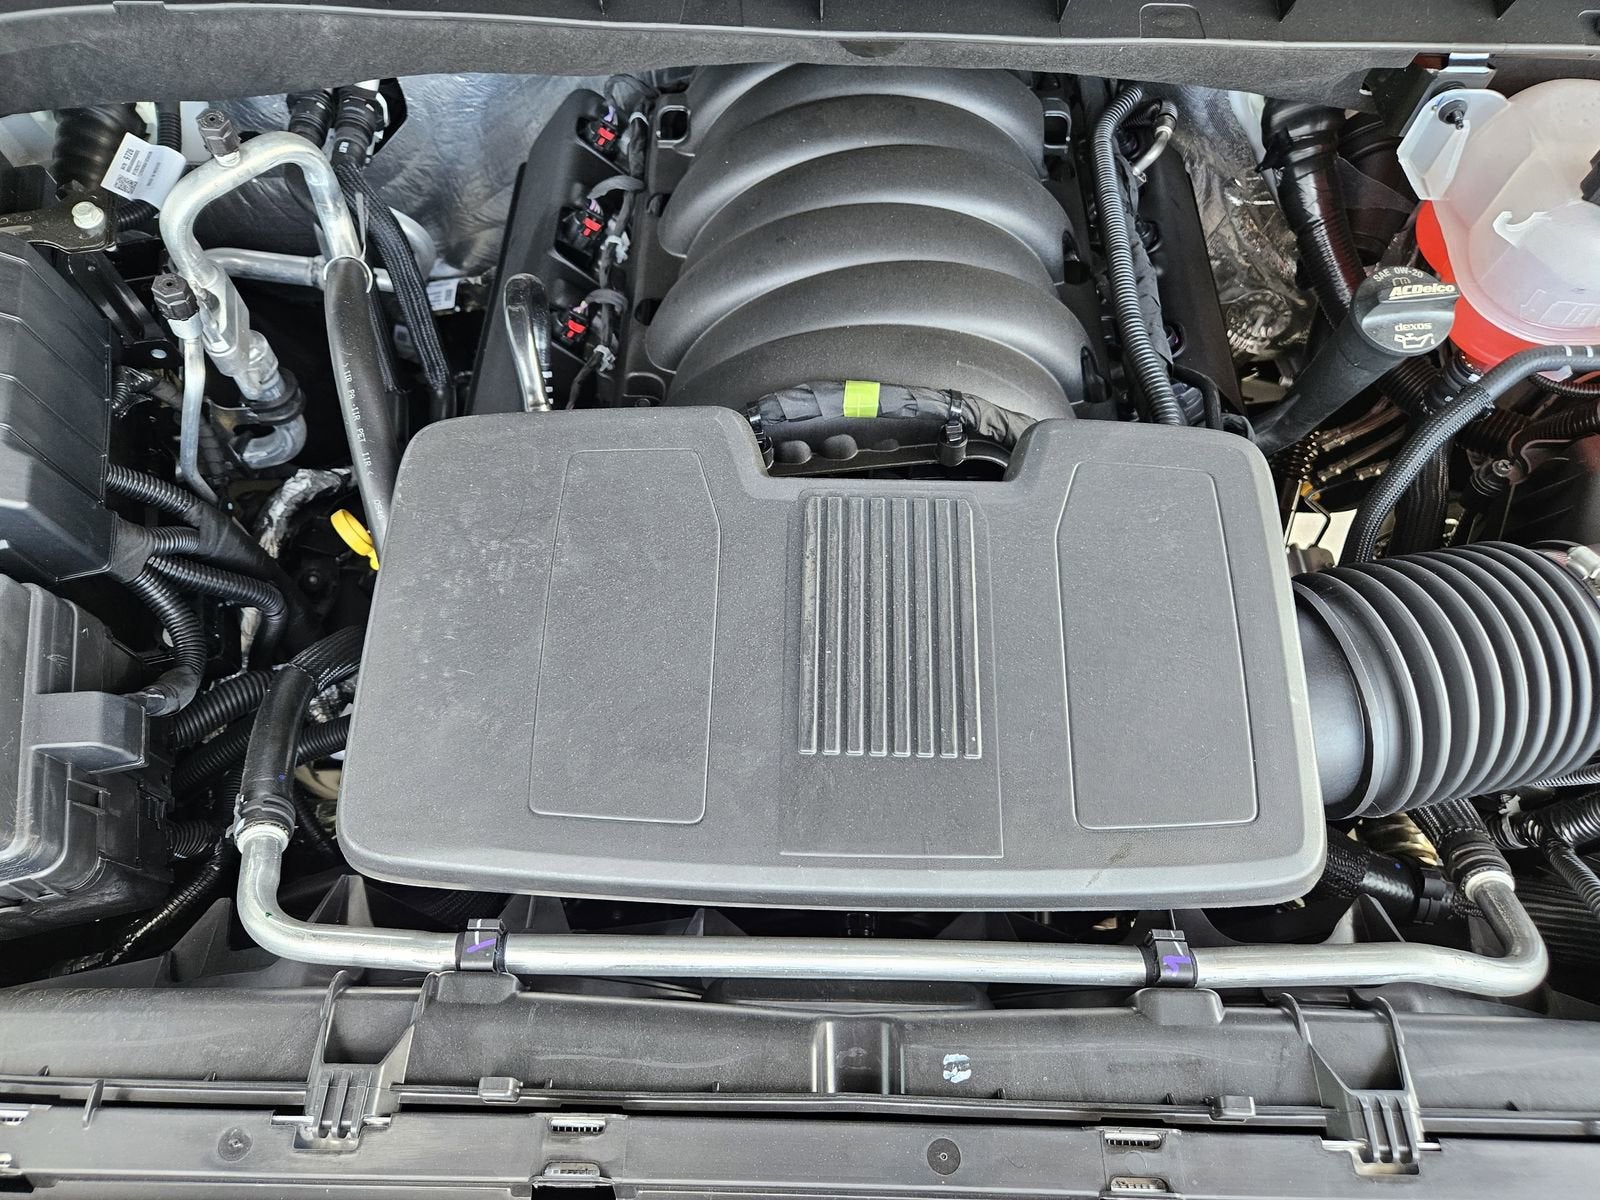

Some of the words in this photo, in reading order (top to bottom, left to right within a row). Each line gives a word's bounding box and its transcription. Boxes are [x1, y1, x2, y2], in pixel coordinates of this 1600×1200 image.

[1373, 269, 1392, 282] SAE
[1394, 266, 1424, 279] 0W-20
[1389, 283, 1456, 297] ACDelco
[1394, 322, 1433, 332] dexos
[347, 389, 356, 400] PA
[357, 427, 367, 443] PET
